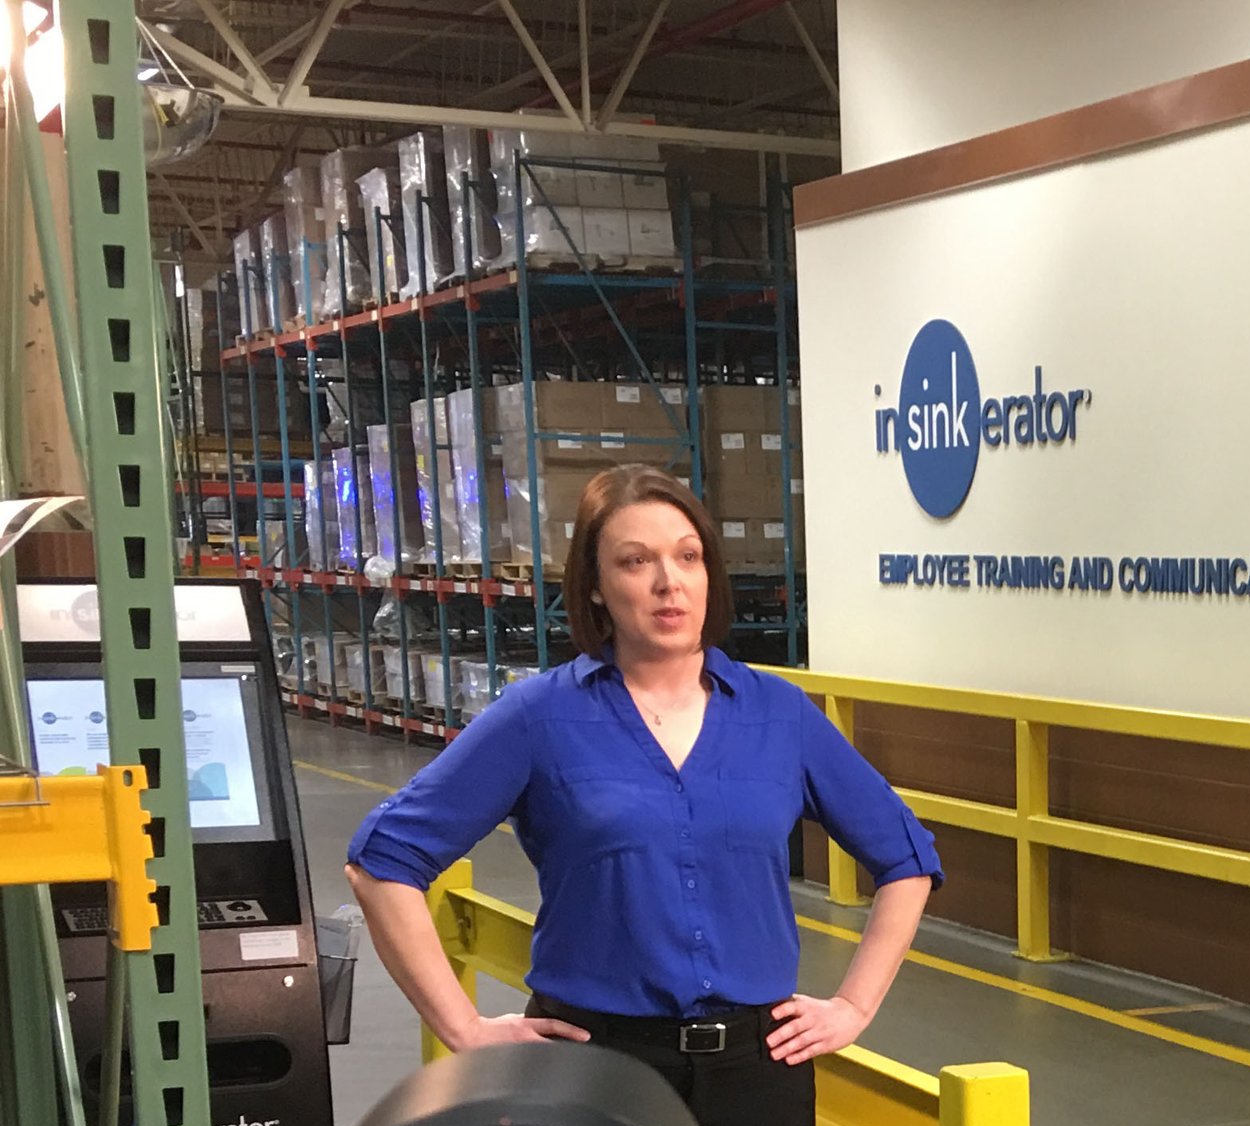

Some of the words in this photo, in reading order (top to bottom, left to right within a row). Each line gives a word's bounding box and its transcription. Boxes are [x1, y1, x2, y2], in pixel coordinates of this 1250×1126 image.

[879, 553, 970, 587] EMPLOYEE
[973, 555, 1066, 590] TRAINING
[1067, 556, 1115, 591] AND
